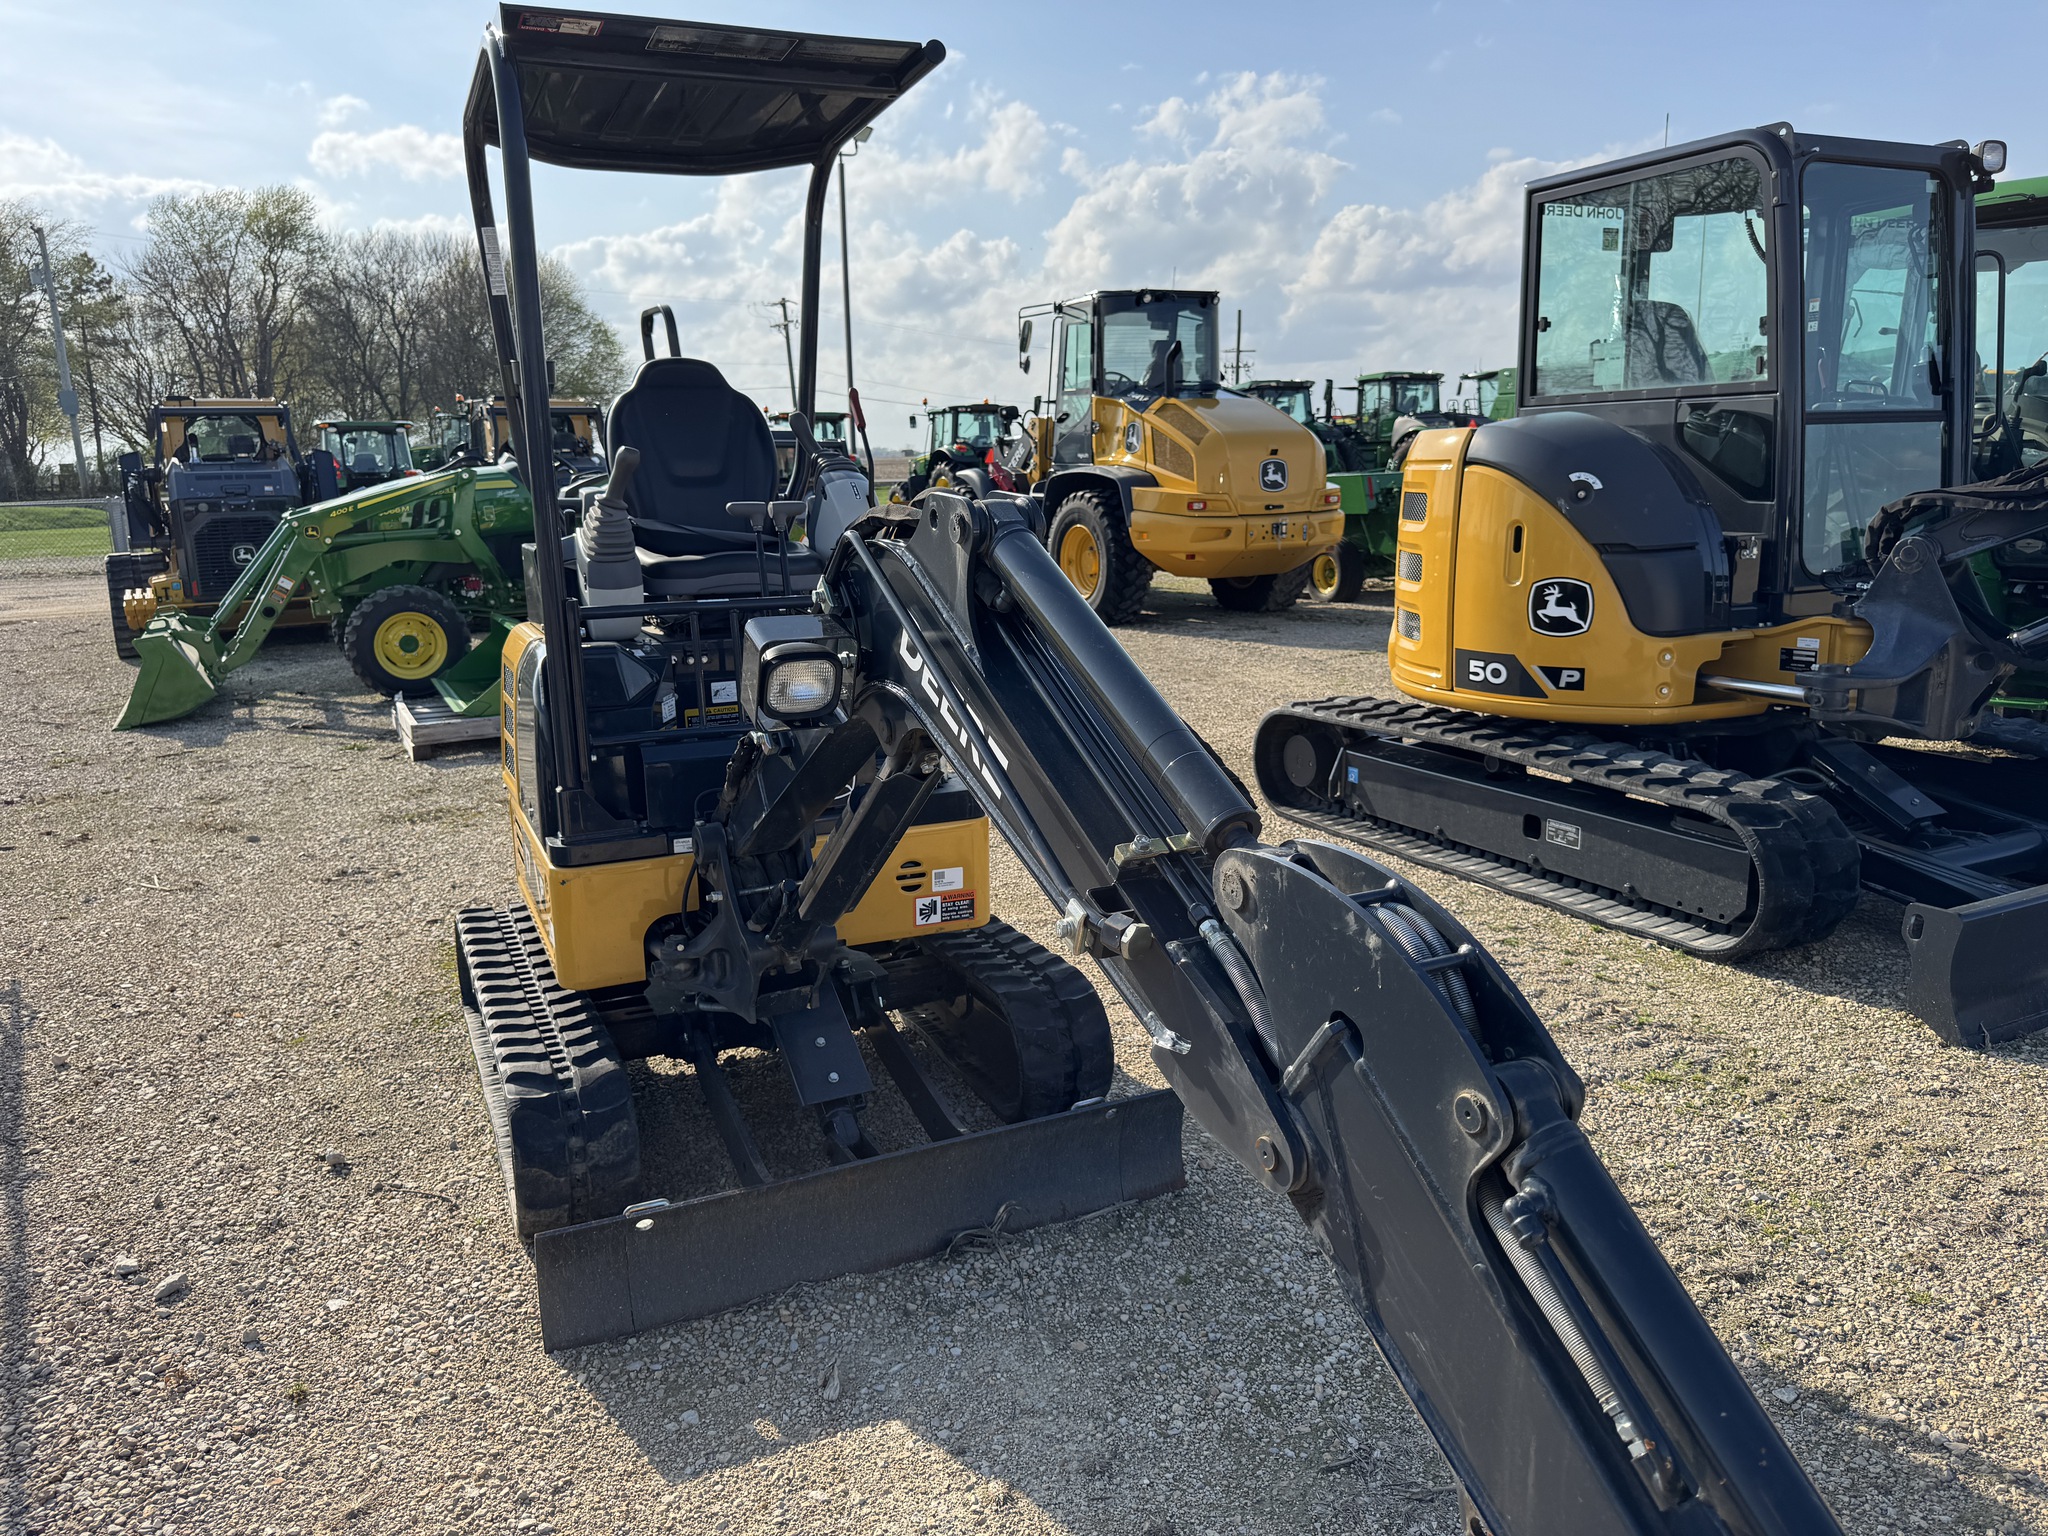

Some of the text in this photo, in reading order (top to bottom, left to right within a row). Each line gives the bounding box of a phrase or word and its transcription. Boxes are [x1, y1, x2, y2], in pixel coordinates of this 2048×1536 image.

[1469, 659, 1580, 687] 50 P
[713, 706, 737, 714] CAUTION
[948, 892, 974, 900] WARNING
